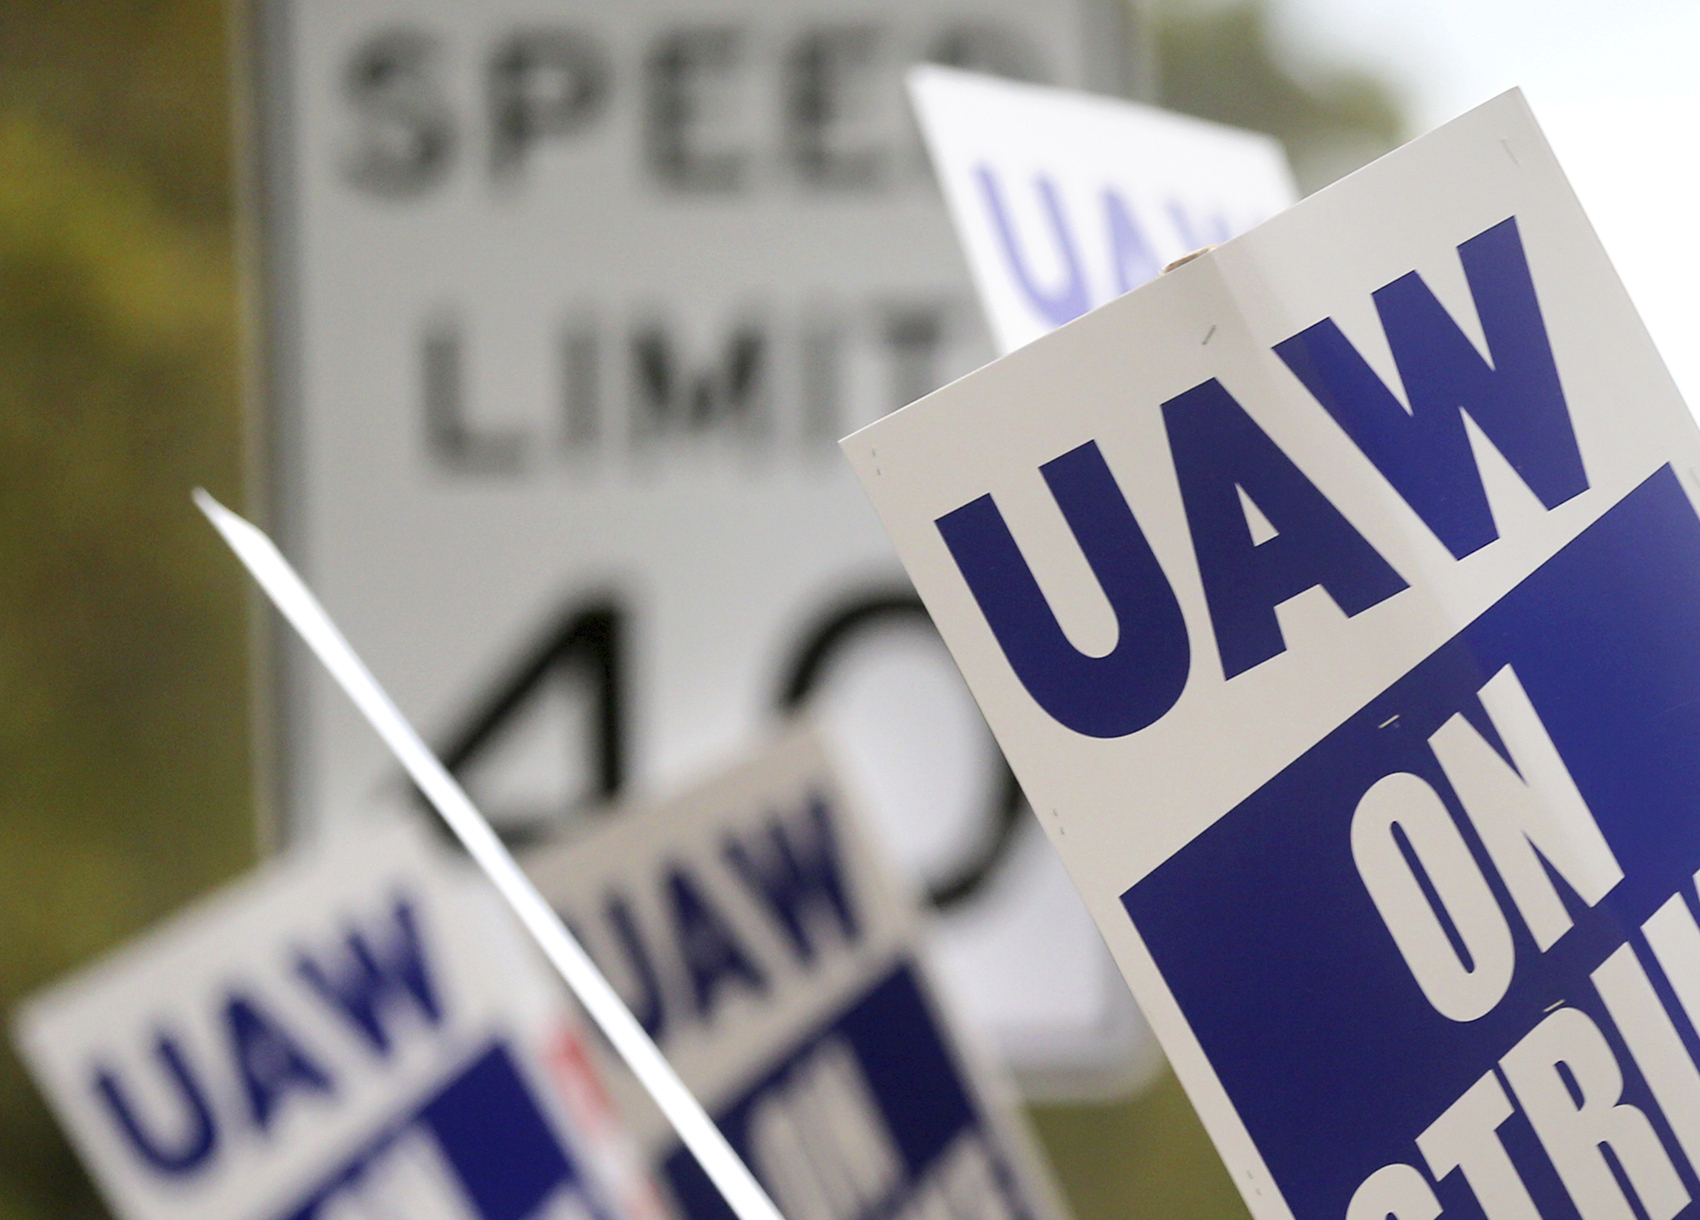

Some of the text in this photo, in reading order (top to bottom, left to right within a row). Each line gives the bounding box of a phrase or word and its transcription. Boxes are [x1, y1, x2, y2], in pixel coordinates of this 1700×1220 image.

[335, 15, 1048, 205] SPEE
[415, 295, 950, 485] LIMIT
[935, 215, 1592, 740] UAW
[1349, 662, 1626, 1023] ON
[90, 886, 446, 1180] UAW
